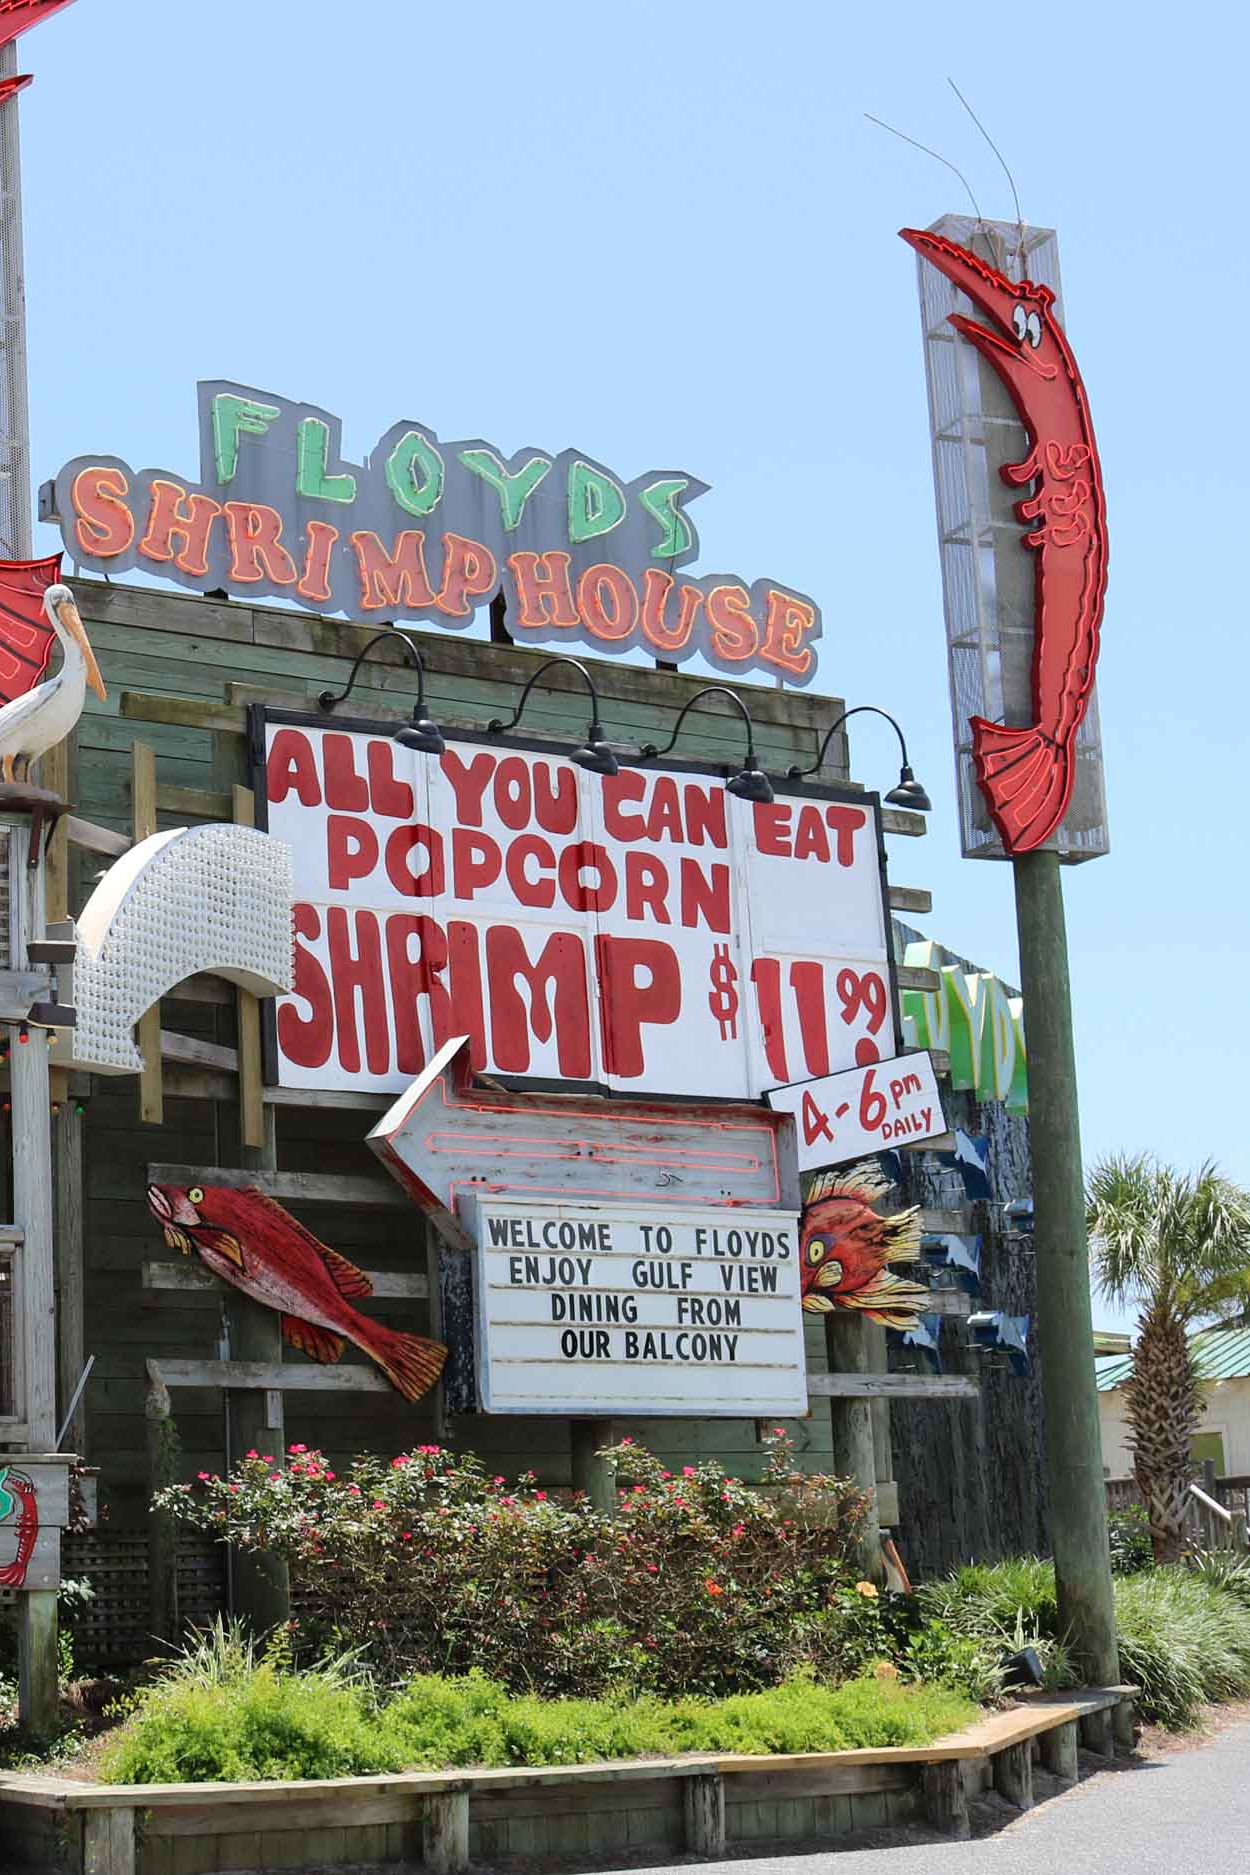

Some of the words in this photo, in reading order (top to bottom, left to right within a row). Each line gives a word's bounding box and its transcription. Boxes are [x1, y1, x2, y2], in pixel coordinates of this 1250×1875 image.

[212, 393, 689, 559] FLOYDS
[71, 466, 497, 616] SHRIMP
[507, 551, 815, 675] HOUSE
[267, 729, 414, 820] ALL
[441, 749, 578, 836] YOU
[602, 767, 728, 849] CAN
[753, 803, 866, 867] EAT
[327, 814, 731, 934] POPCORN
[278, 903, 681, 1078] SHRIMP
[882, 1107, 932, 1140] DAILY
[488, 1218, 613, 1251] WELCOME
[639, 1226, 672, 1254] TO
[696, 1229, 791, 1260] FLOYDS
[510, 1256, 593, 1285] ENJOY
[632, 1260, 693, 1289] GULF
[720, 1264, 778, 1293] VIEW
[551, 1294, 638, 1323] DINING
[677, 1297, 741, 1326] FROM
[561, 1329, 611, 1358] OUR
[625, 1331, 739, 1361] BALCONY
